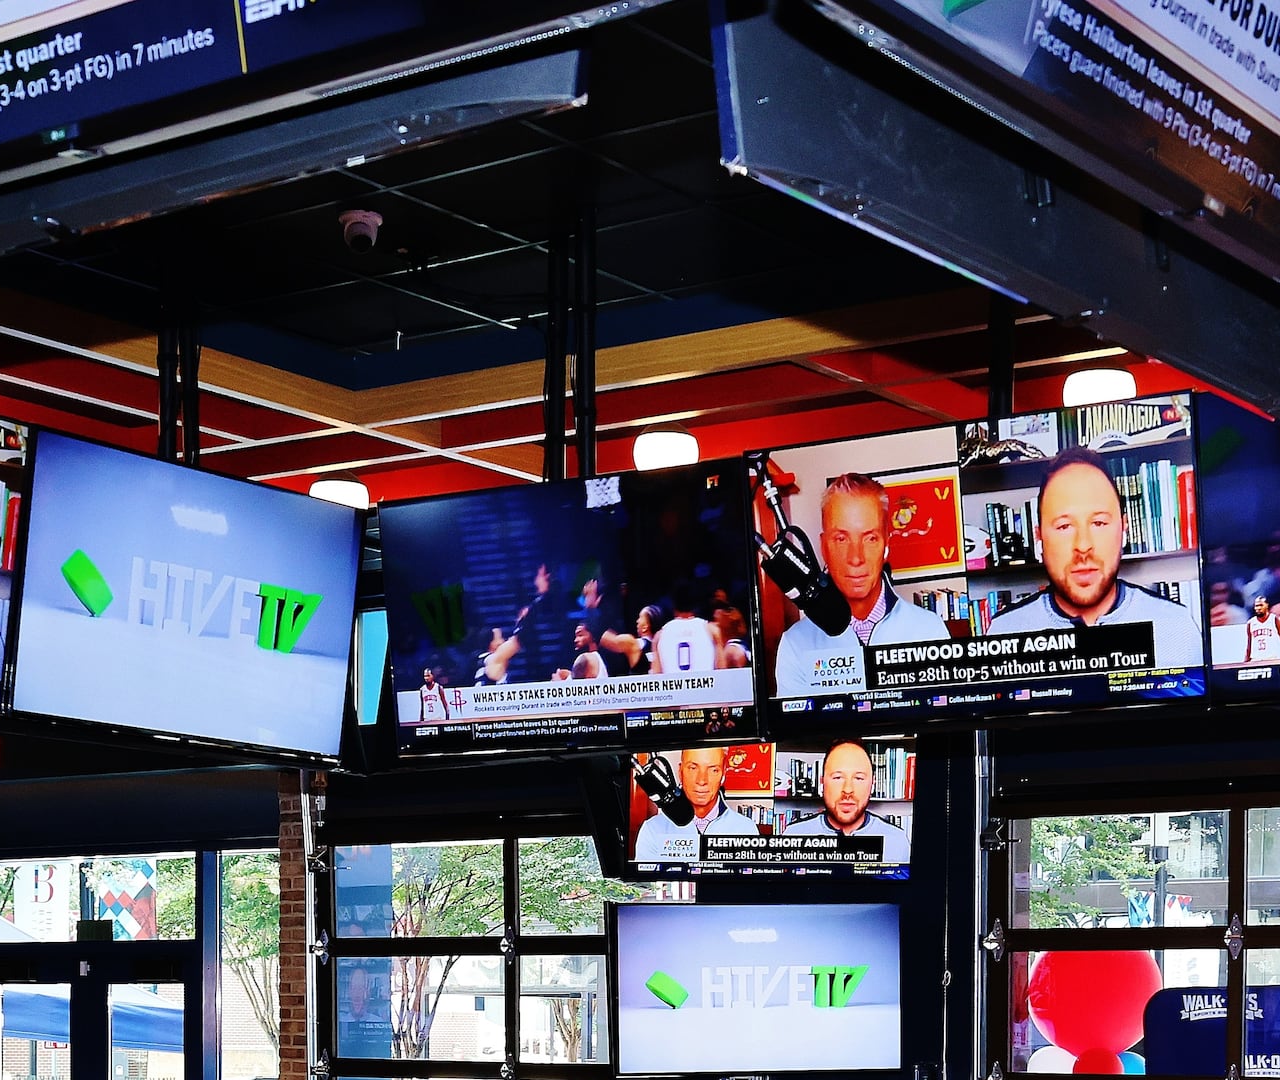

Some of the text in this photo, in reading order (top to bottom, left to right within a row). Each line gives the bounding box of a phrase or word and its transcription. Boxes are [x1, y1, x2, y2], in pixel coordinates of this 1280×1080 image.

[15, 31, 81, 71] quarter
[27, 77, 48, 97] on
[49, 62, 83, 91] 3-pt
[83, 54, 113, 80] FG)
[115, 52, 131, 70] in
[132, 42, 143, 66] 7
[146, 27, 214, 62] minutes
[875, 633, 1075, 665] FLEETWOOD SHORT AGAIN
[877, 651, 1147, 689] Earns 28th top-5 without a win on Tour
[473, 677, 713, 703] WHAT'S AT STAKE FOR DURANT ON ANOTHER NEW TEAM?
[707, 837, 837, 847] FLEETWOOD SHORT AGAIN
